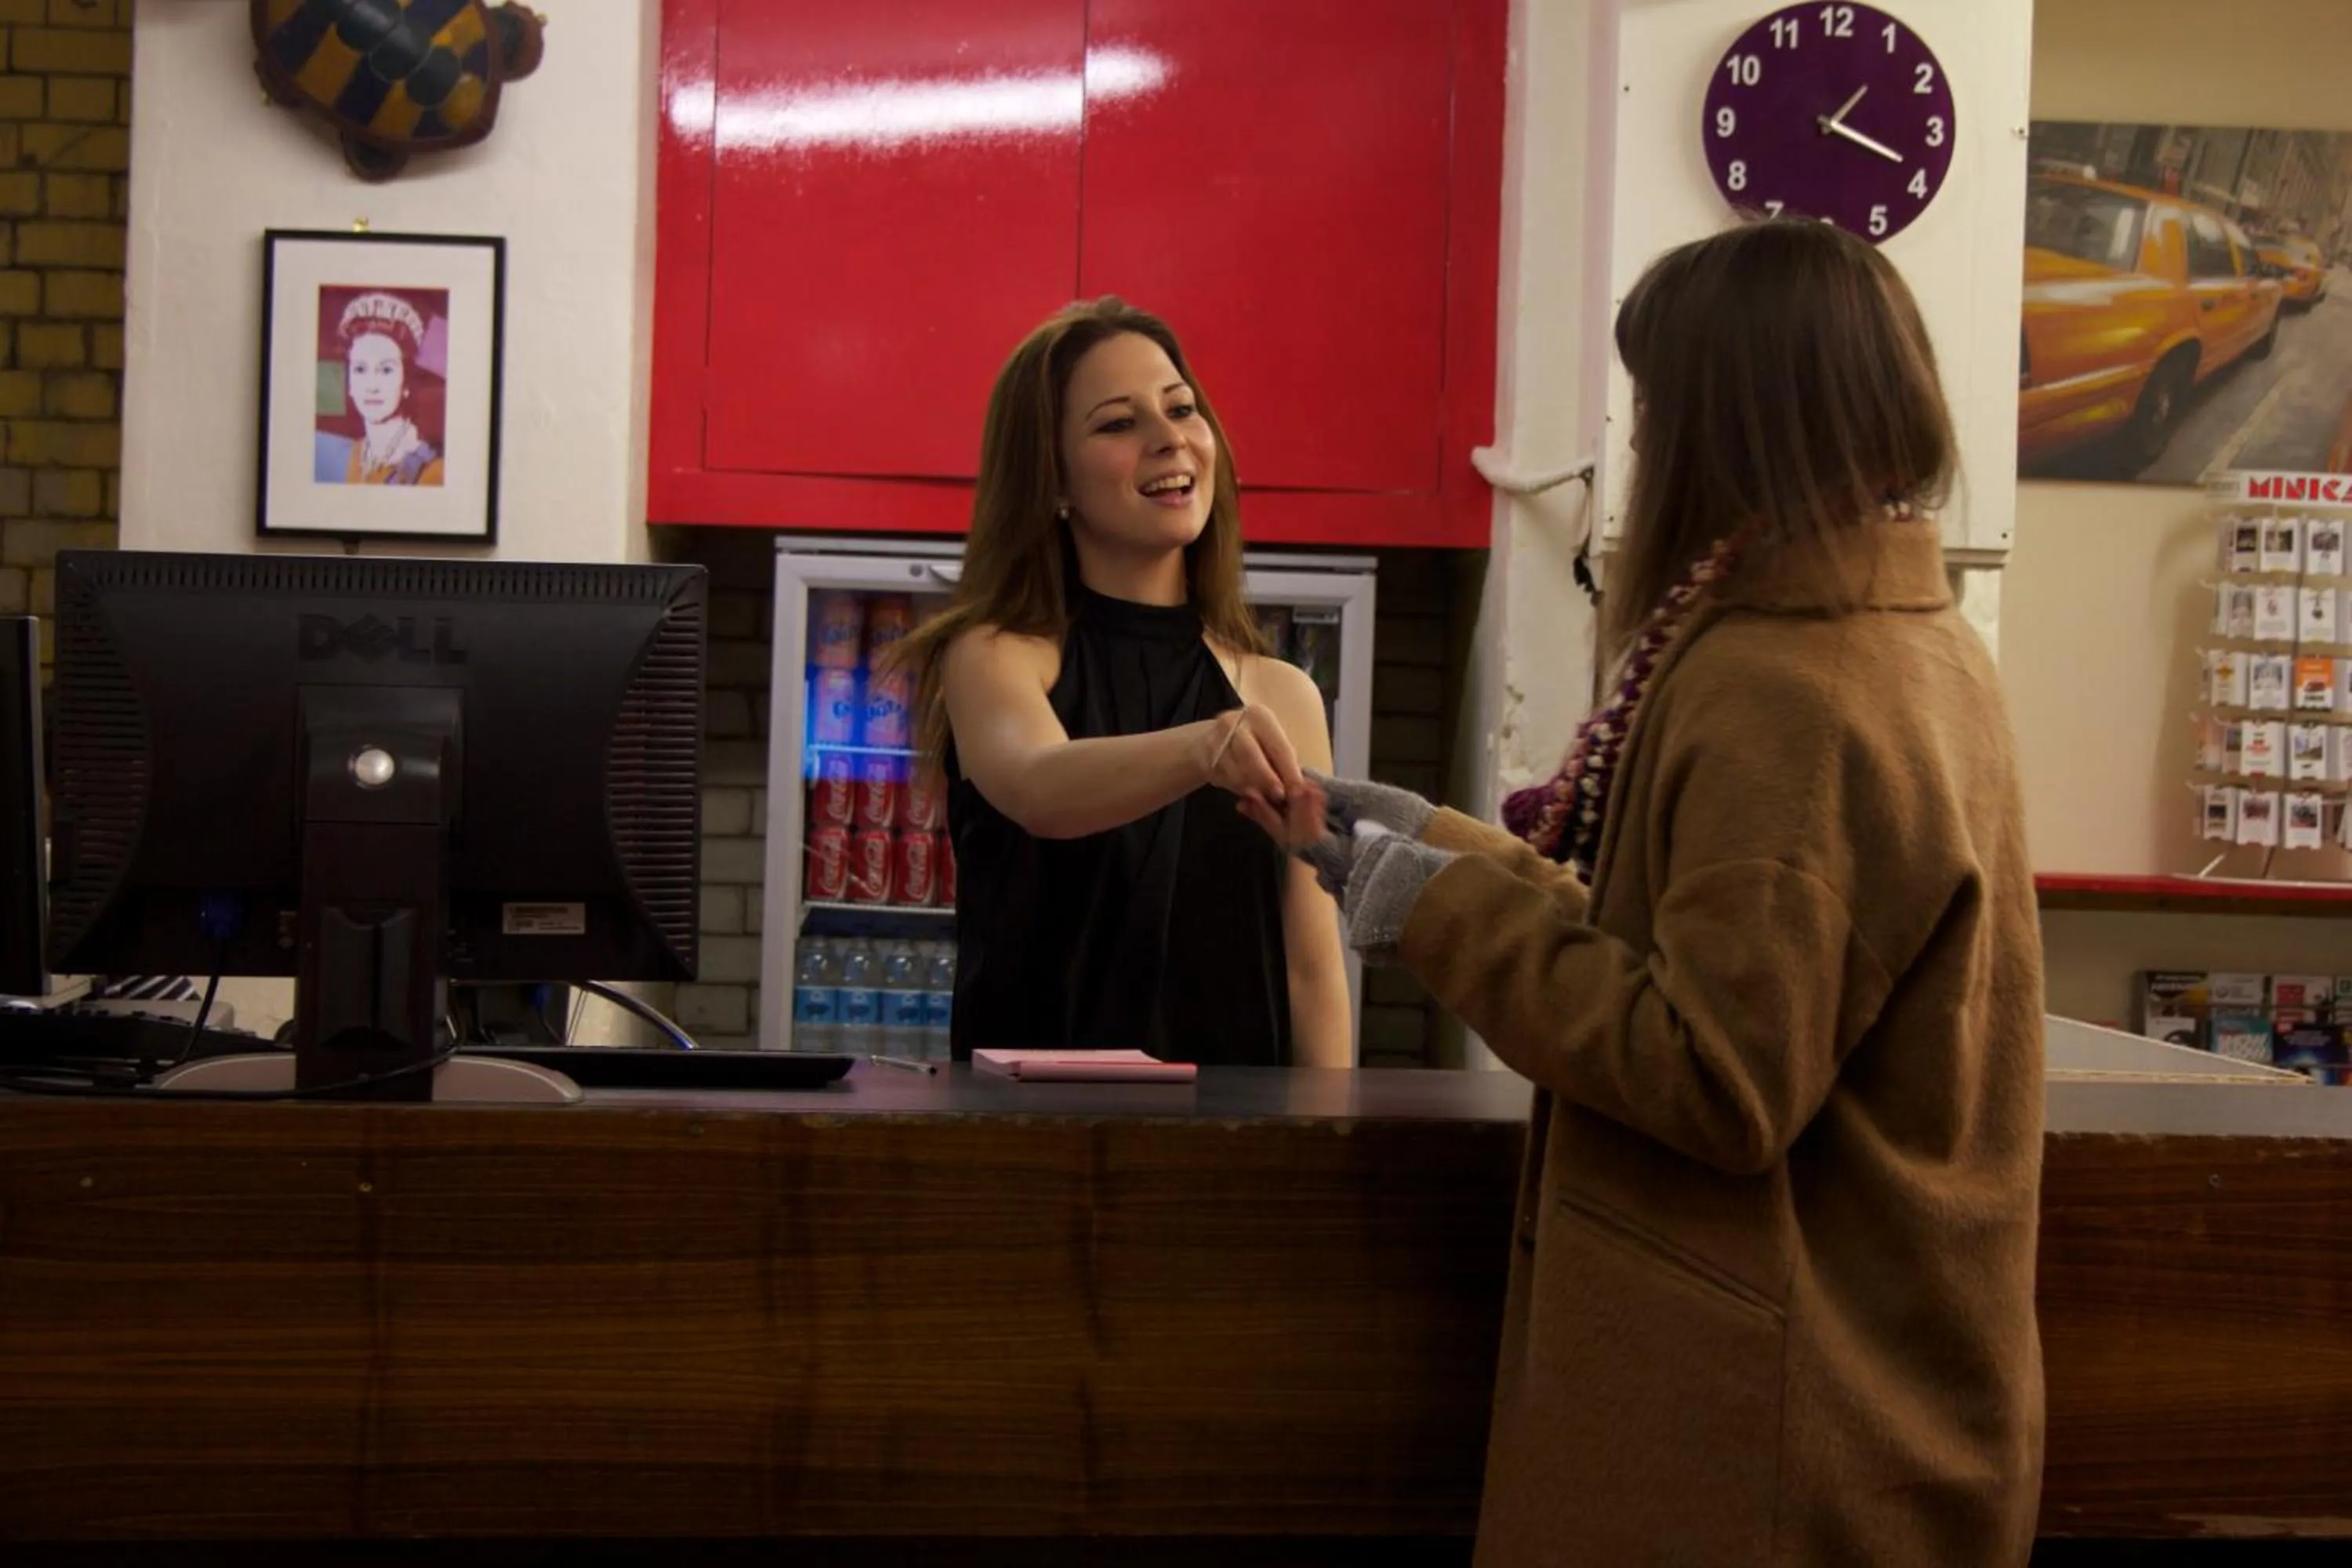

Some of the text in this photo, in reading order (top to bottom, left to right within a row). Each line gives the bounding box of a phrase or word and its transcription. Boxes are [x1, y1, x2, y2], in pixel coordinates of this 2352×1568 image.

[1769, 17, 1798, 49] 11
[1820, 5, 1854, 38] 12
[1882, 22, 1896, 53] 1
[1726, 54, 1761, 85] 10
[1913, 62, 1934, 94] 2
[1716, 107, 1736, 137] 9
[1926, 115, 1944, 147] 3
[1727, 160, 1747, 191] 8
[1907, 169, 1928, 199] 4
[1868, 205, 1888, 236] 5
[298, 612, 469, 665] DELL
